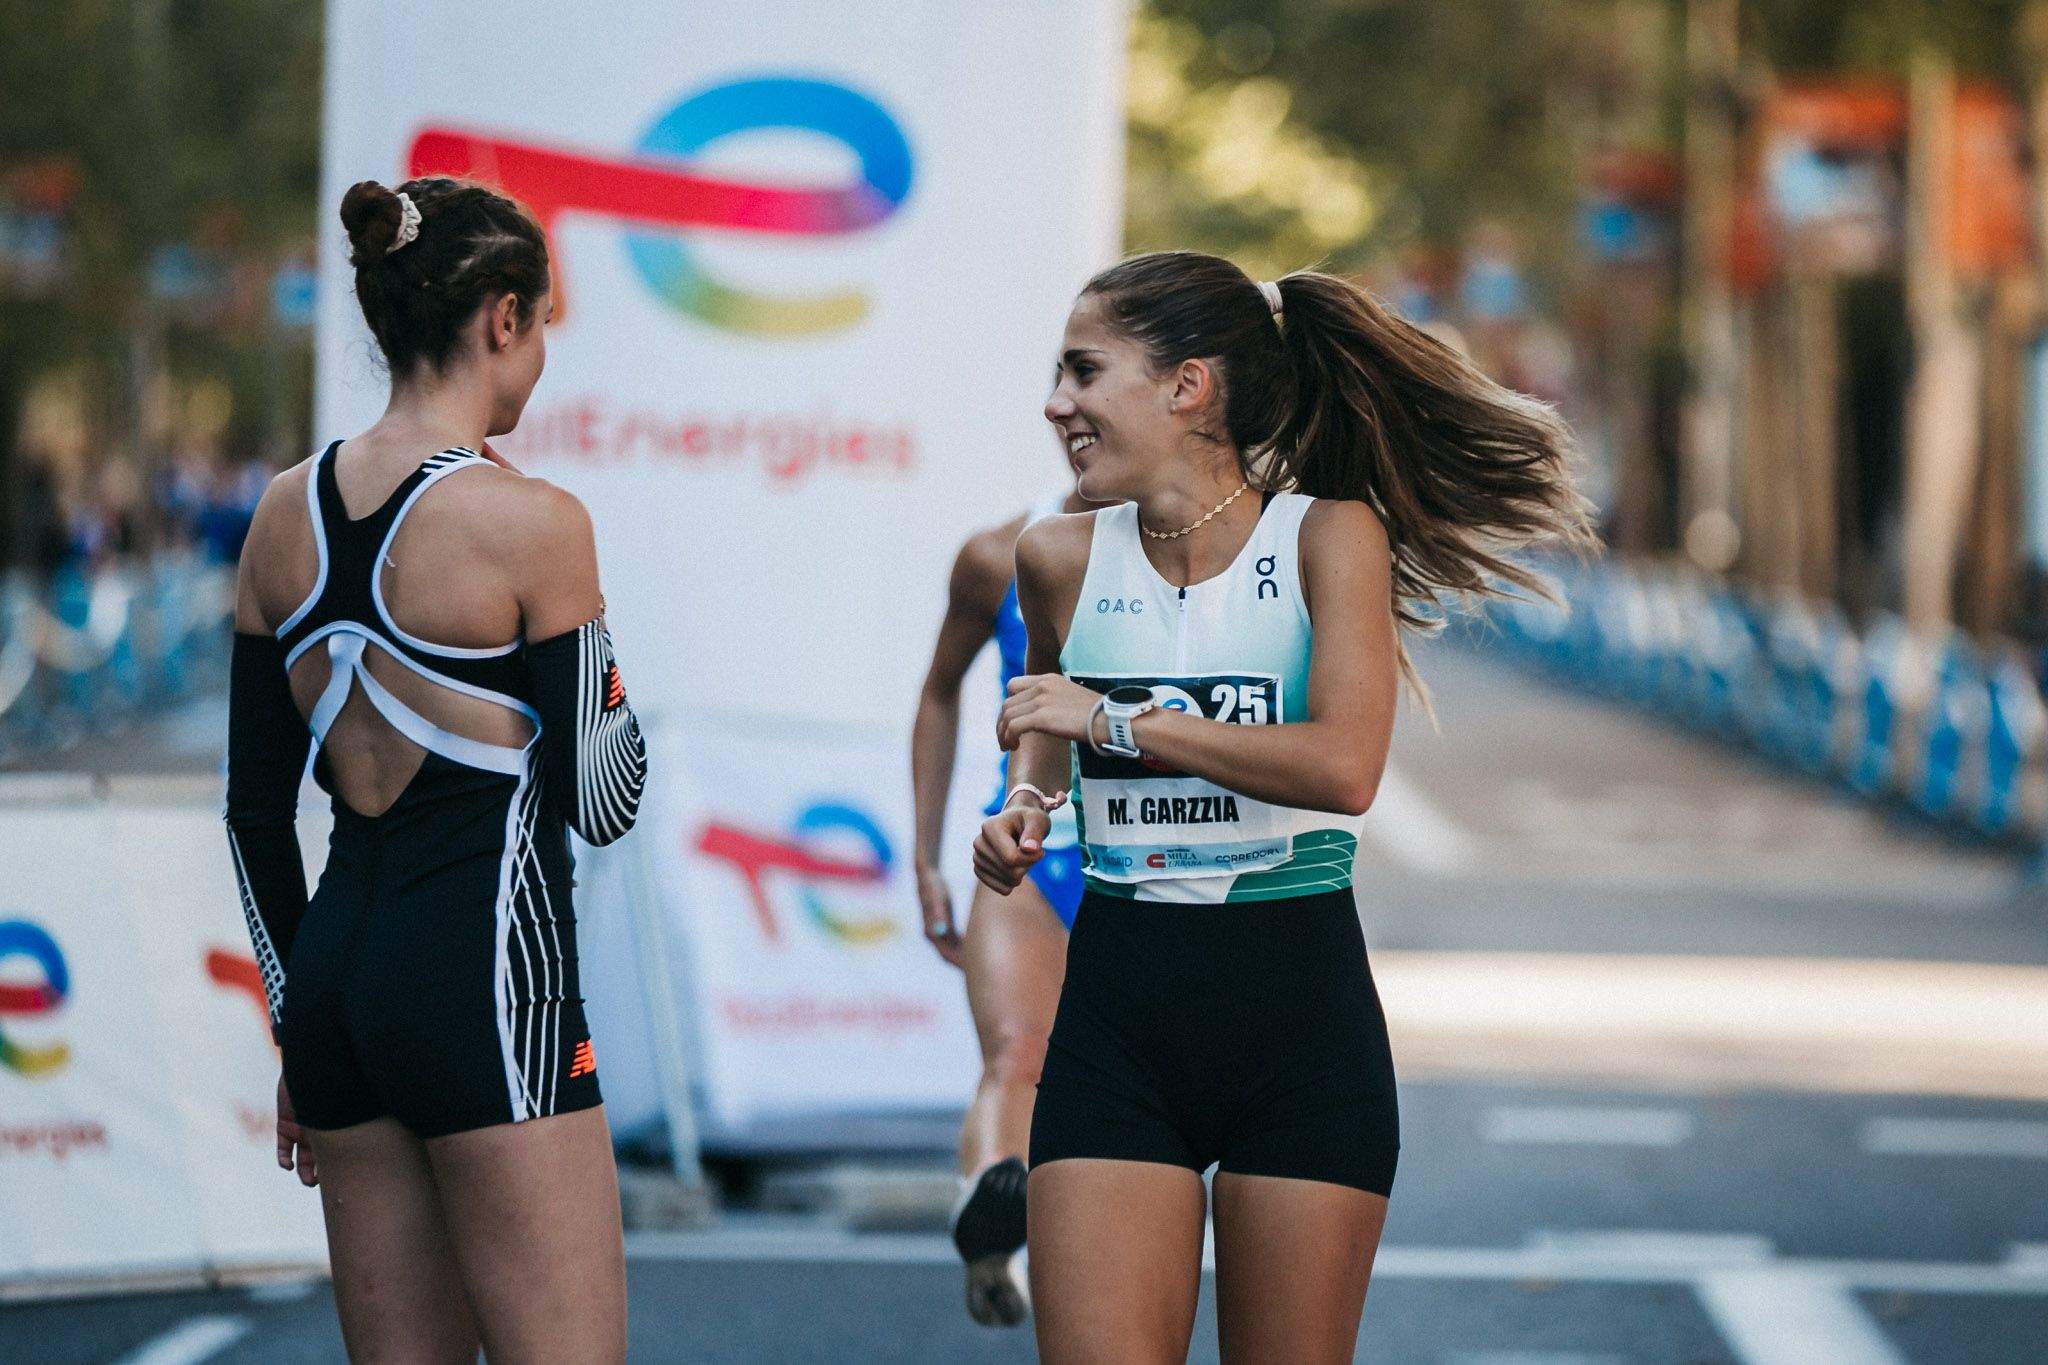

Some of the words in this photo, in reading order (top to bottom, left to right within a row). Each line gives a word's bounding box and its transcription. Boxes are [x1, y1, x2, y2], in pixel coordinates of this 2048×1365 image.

[1097, 598, 1144, 615] OAC
[1211, 684, 1267, 725] 25
[1107, 798, 1134, 825] M.
[1140, 796, 1240, 824] GARZZIA
